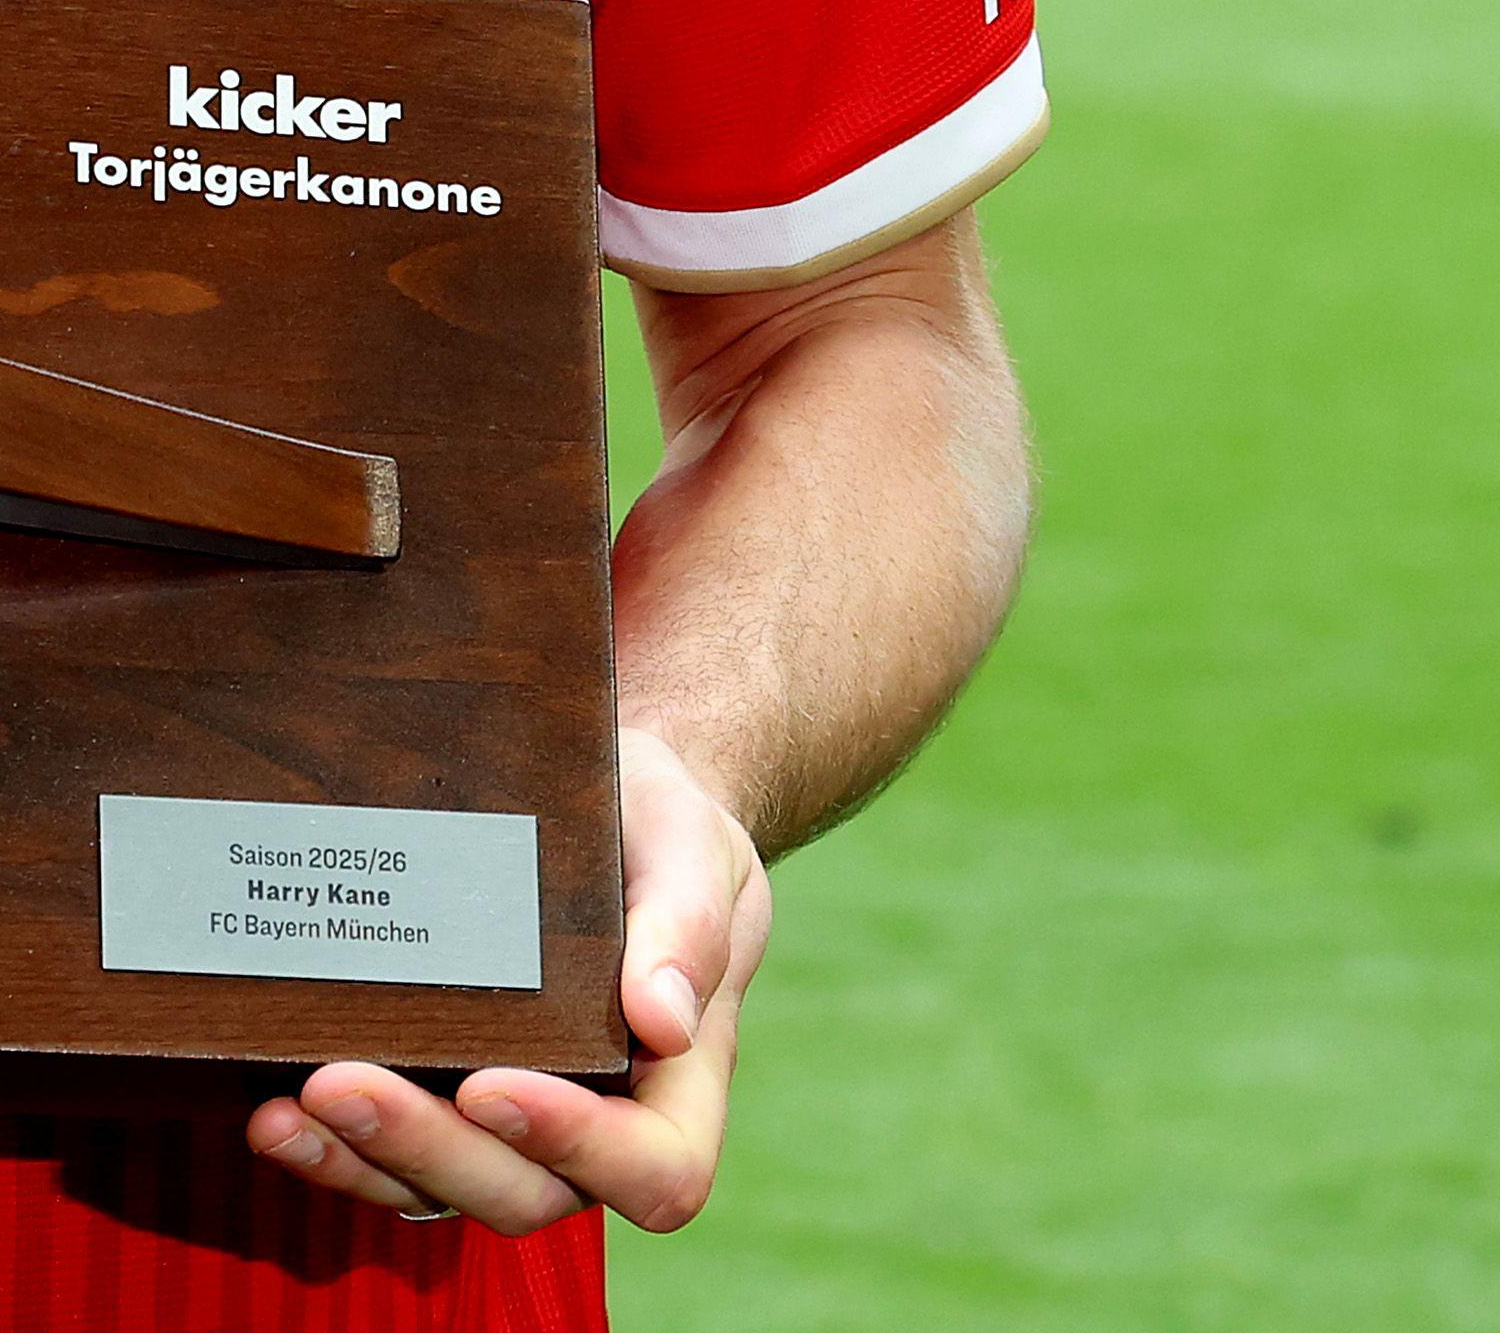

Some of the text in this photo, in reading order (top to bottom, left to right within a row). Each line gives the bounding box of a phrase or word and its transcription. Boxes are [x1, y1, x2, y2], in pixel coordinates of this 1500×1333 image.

[169, 65, 401, 143] kicker
[69, 141, 502, 216] Torjägerkanone
[229, 843, 407, 875] Saison 2025/26
[248, 879, 391, 907] Harry Kane
[210, 912, 429, 943] FC Bayern München
